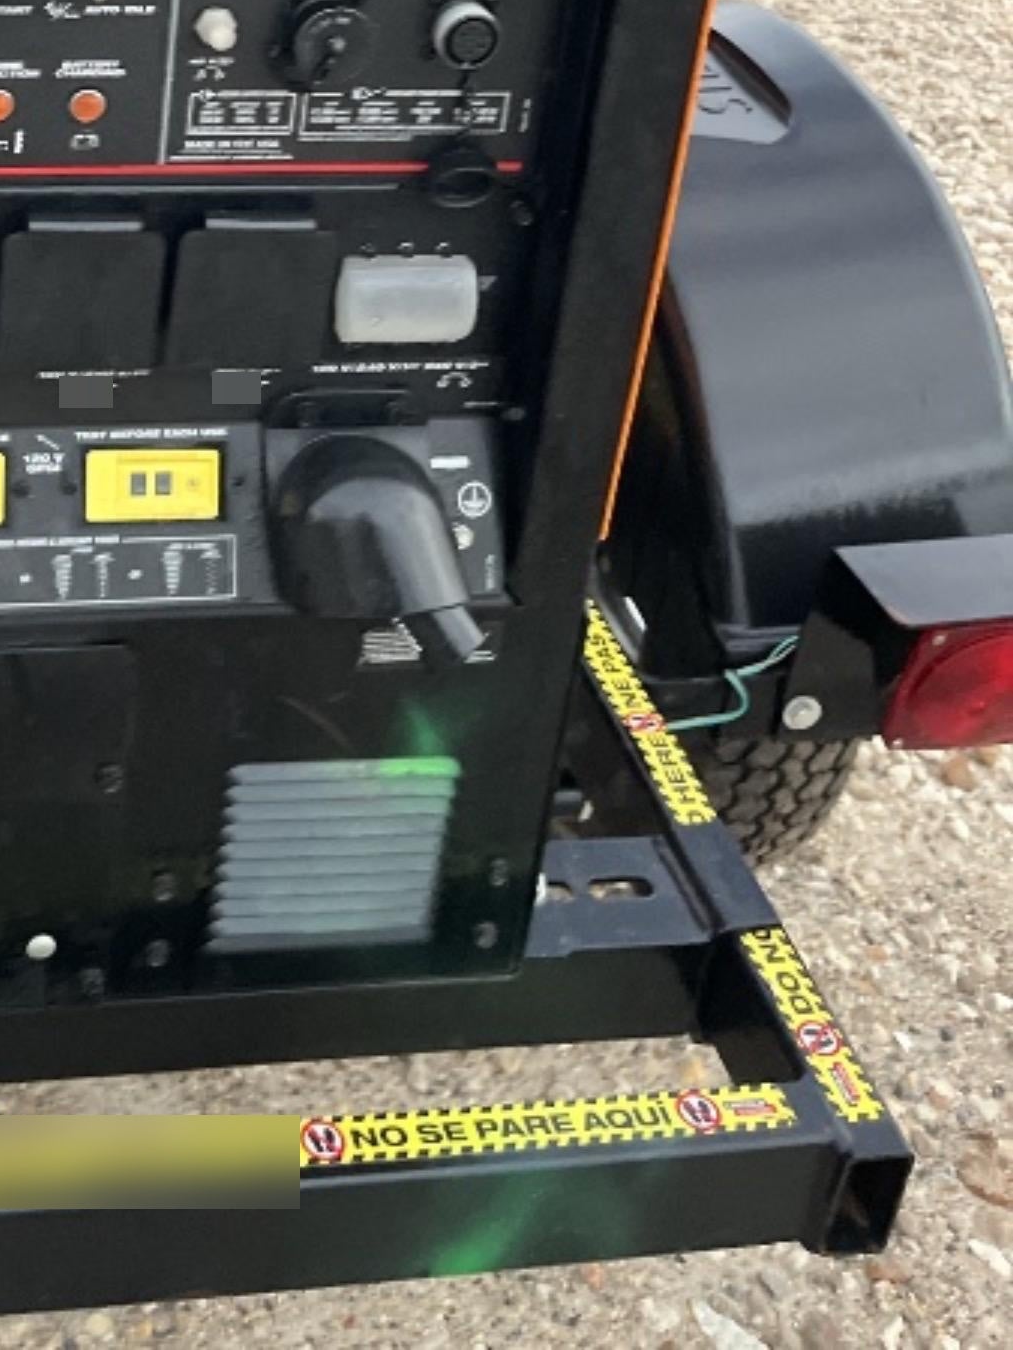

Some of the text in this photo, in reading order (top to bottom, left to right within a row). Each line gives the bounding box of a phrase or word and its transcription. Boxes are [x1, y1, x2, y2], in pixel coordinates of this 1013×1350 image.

[650, 734, 697, 804] HERE
[775, 969, 815, 1015] DO
[350, 1127, 408, 1149] NO
[420, 1121, 469, 1145] SE
[473, 1114, 577, 1142] PARE
